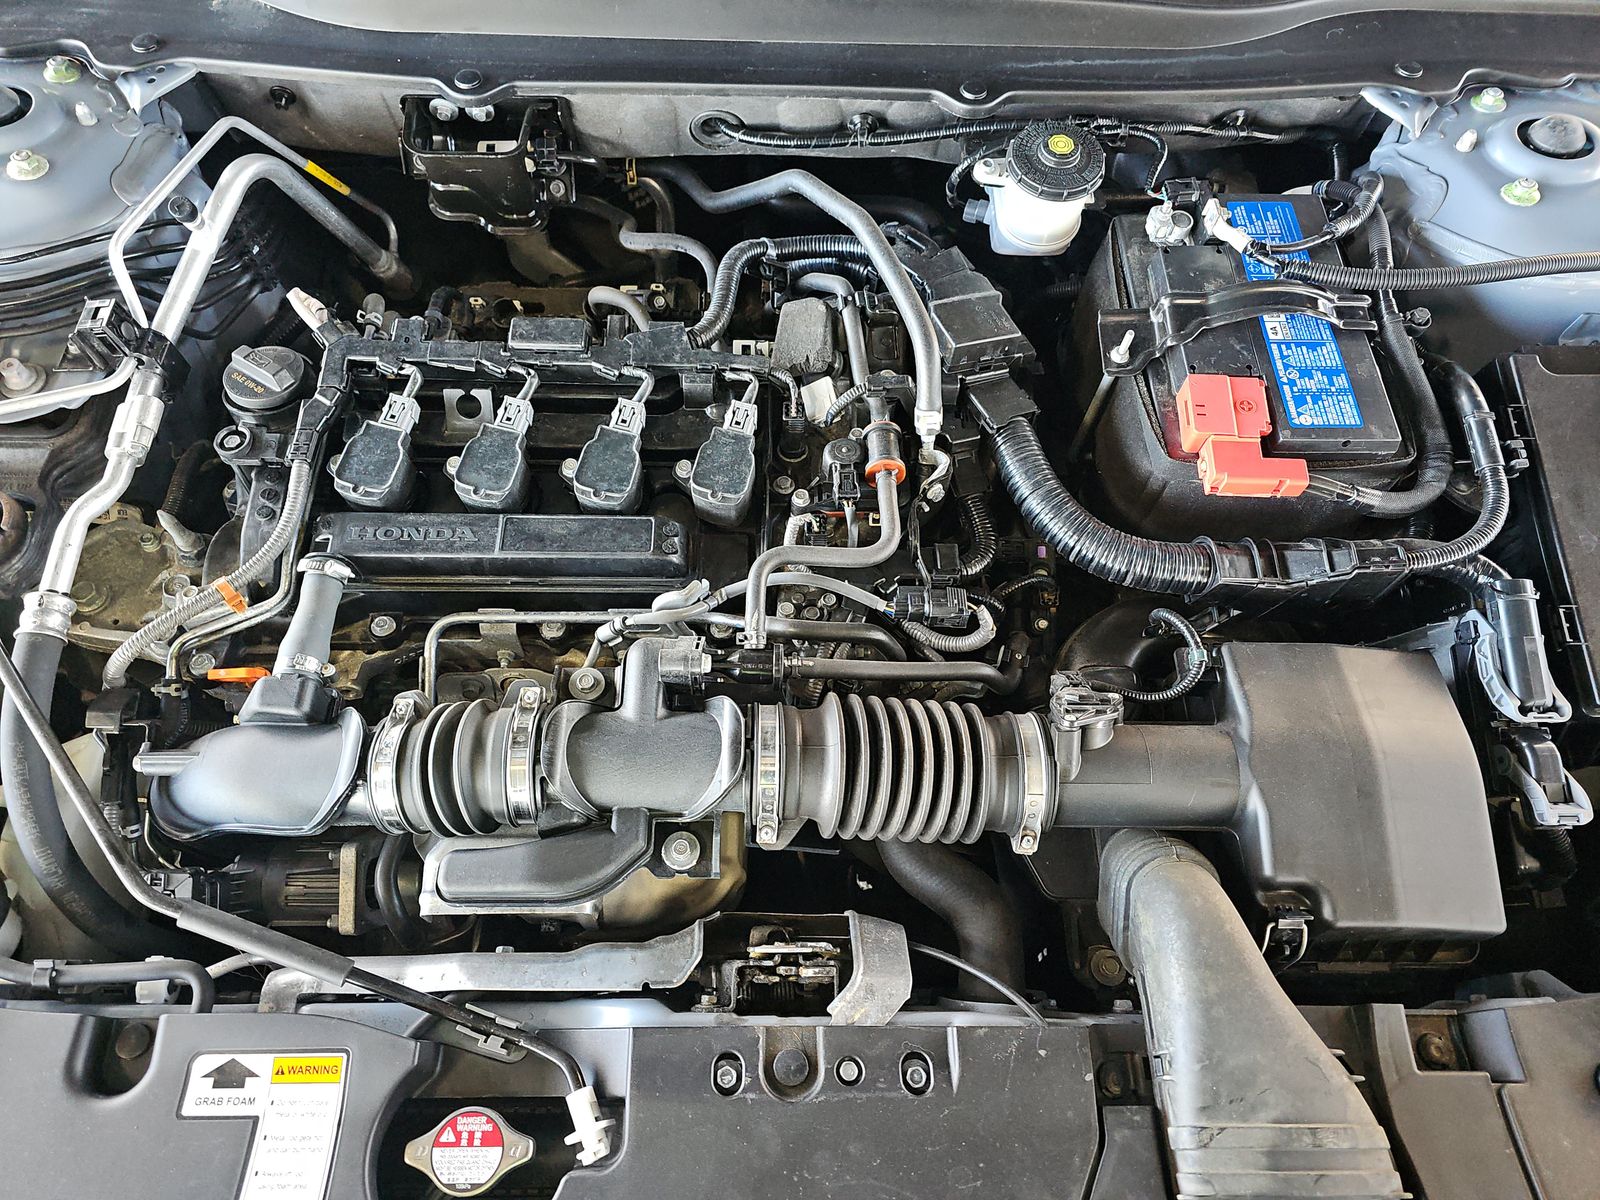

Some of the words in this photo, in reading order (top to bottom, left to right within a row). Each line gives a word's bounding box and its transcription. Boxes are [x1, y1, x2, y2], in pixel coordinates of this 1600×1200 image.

[231, 372, 246, 383] SAE
[245, 380, 265, 394] 0W-20
[346, 525, 479, 542] HONDA
[287, 1065, 339, 1075] WARNING
[194, 1096, 223, 1106] GRAB
[227, 1096, 256, 1106] FOAM
[456, 1116, 488, 1124] DANGER
